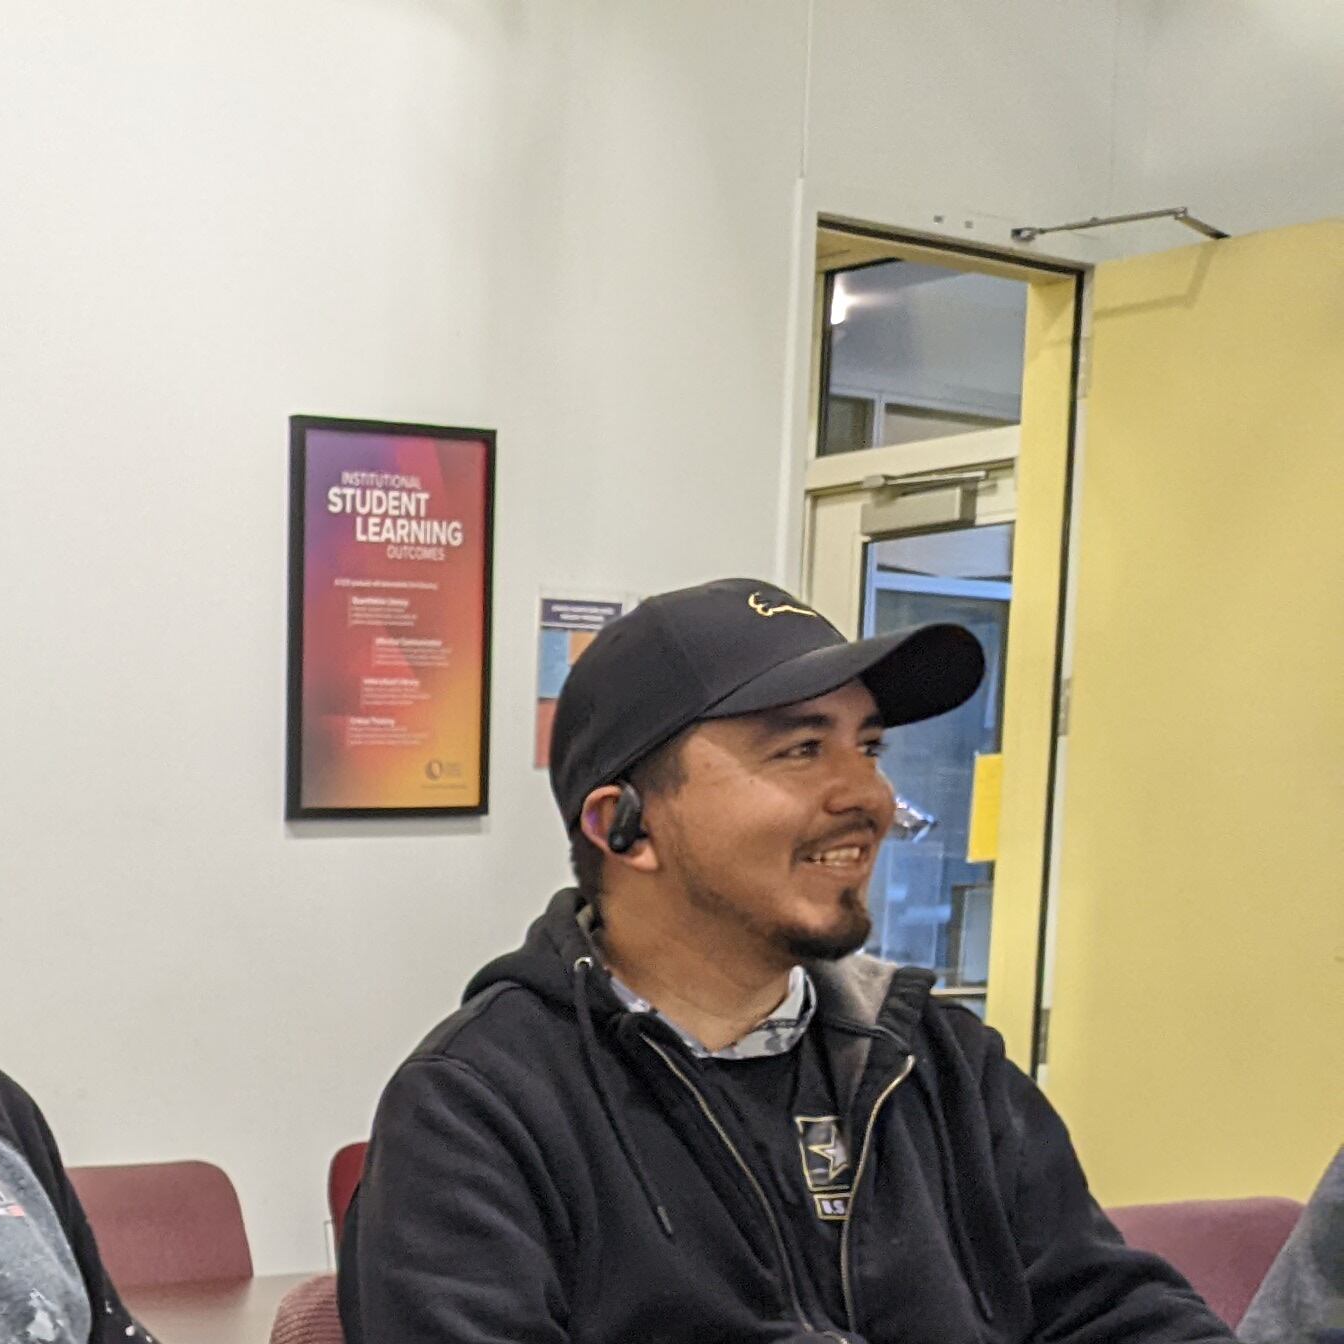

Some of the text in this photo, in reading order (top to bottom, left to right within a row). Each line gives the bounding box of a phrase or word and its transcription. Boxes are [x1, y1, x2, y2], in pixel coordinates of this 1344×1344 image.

[341, 471, 423, 490] INSTITUTIONAL
[327, 486, 430, 518] STUDENT
[355, 517, 464, 547] LEARNING
[386, 545, 446, 561] OUTCOMES
